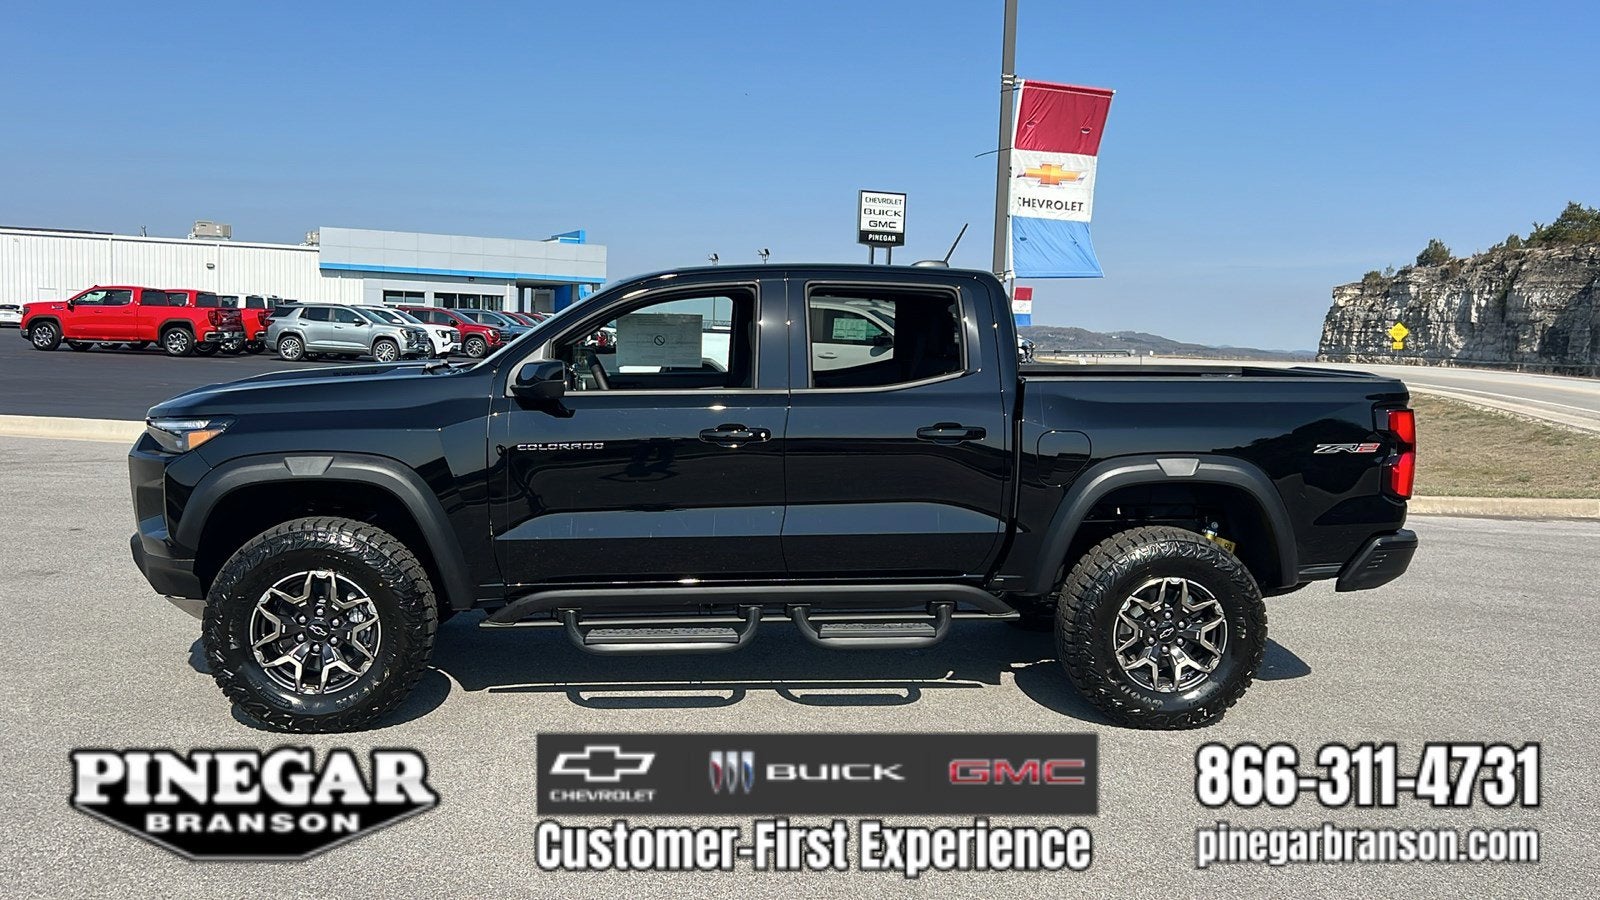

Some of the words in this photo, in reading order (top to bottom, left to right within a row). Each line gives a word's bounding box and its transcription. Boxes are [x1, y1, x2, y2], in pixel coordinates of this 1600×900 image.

[865, 196, 902, 205] CHEVROLET
[863, 208, 902, 217] BUICK
[868, 220, 897, 229] GMC
[868, 233, 897, 242] PINEGAR
[517, 442, 604, 451] COLORADO
[1313, 443, 1380, 454] ZR2
